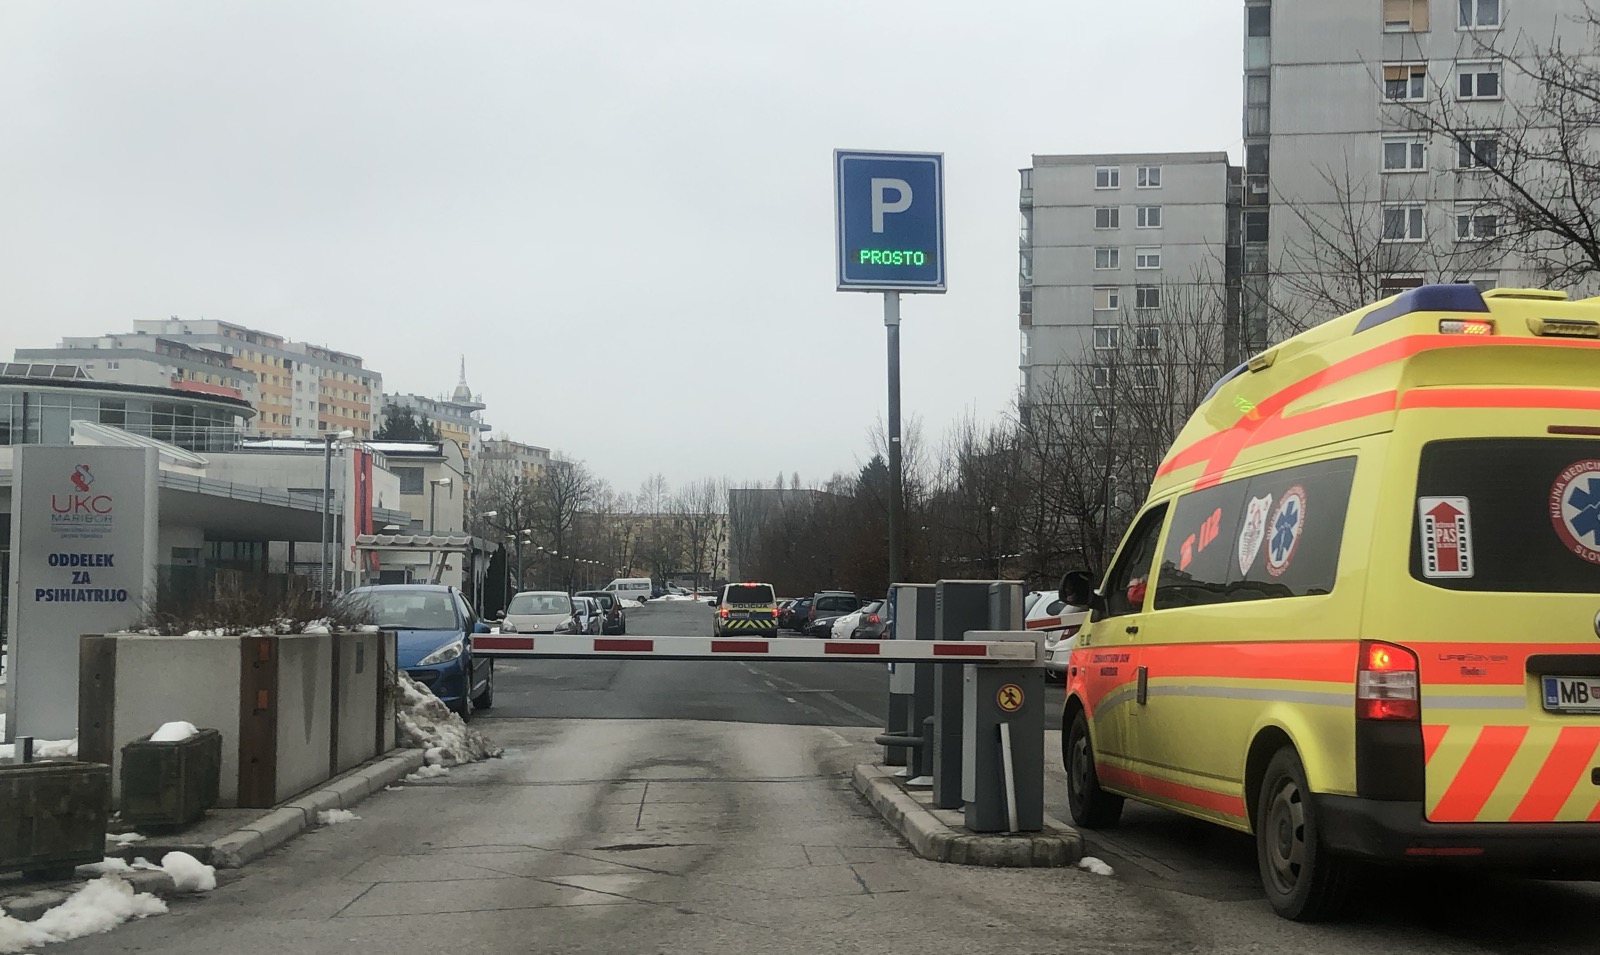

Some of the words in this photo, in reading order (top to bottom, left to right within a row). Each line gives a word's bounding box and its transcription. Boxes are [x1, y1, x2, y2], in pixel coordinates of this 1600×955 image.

[870, 177, 913, 233] P
[859, 249, 925, 266] PROSTO
[51, 494, 113, 514] UKC
[1551, 481, 1566, 519] NUJNA
[51, 514, 113, 523] MARIBOR
[1436, 528, 1457, 543] PAS
[48, 553, 114, 568] ODDELEK
[71, 571, 91, 585] ZA
[35, 588, 128, 602] PSIHIATRIJO
[1560, 681, 1589, 704] MB
